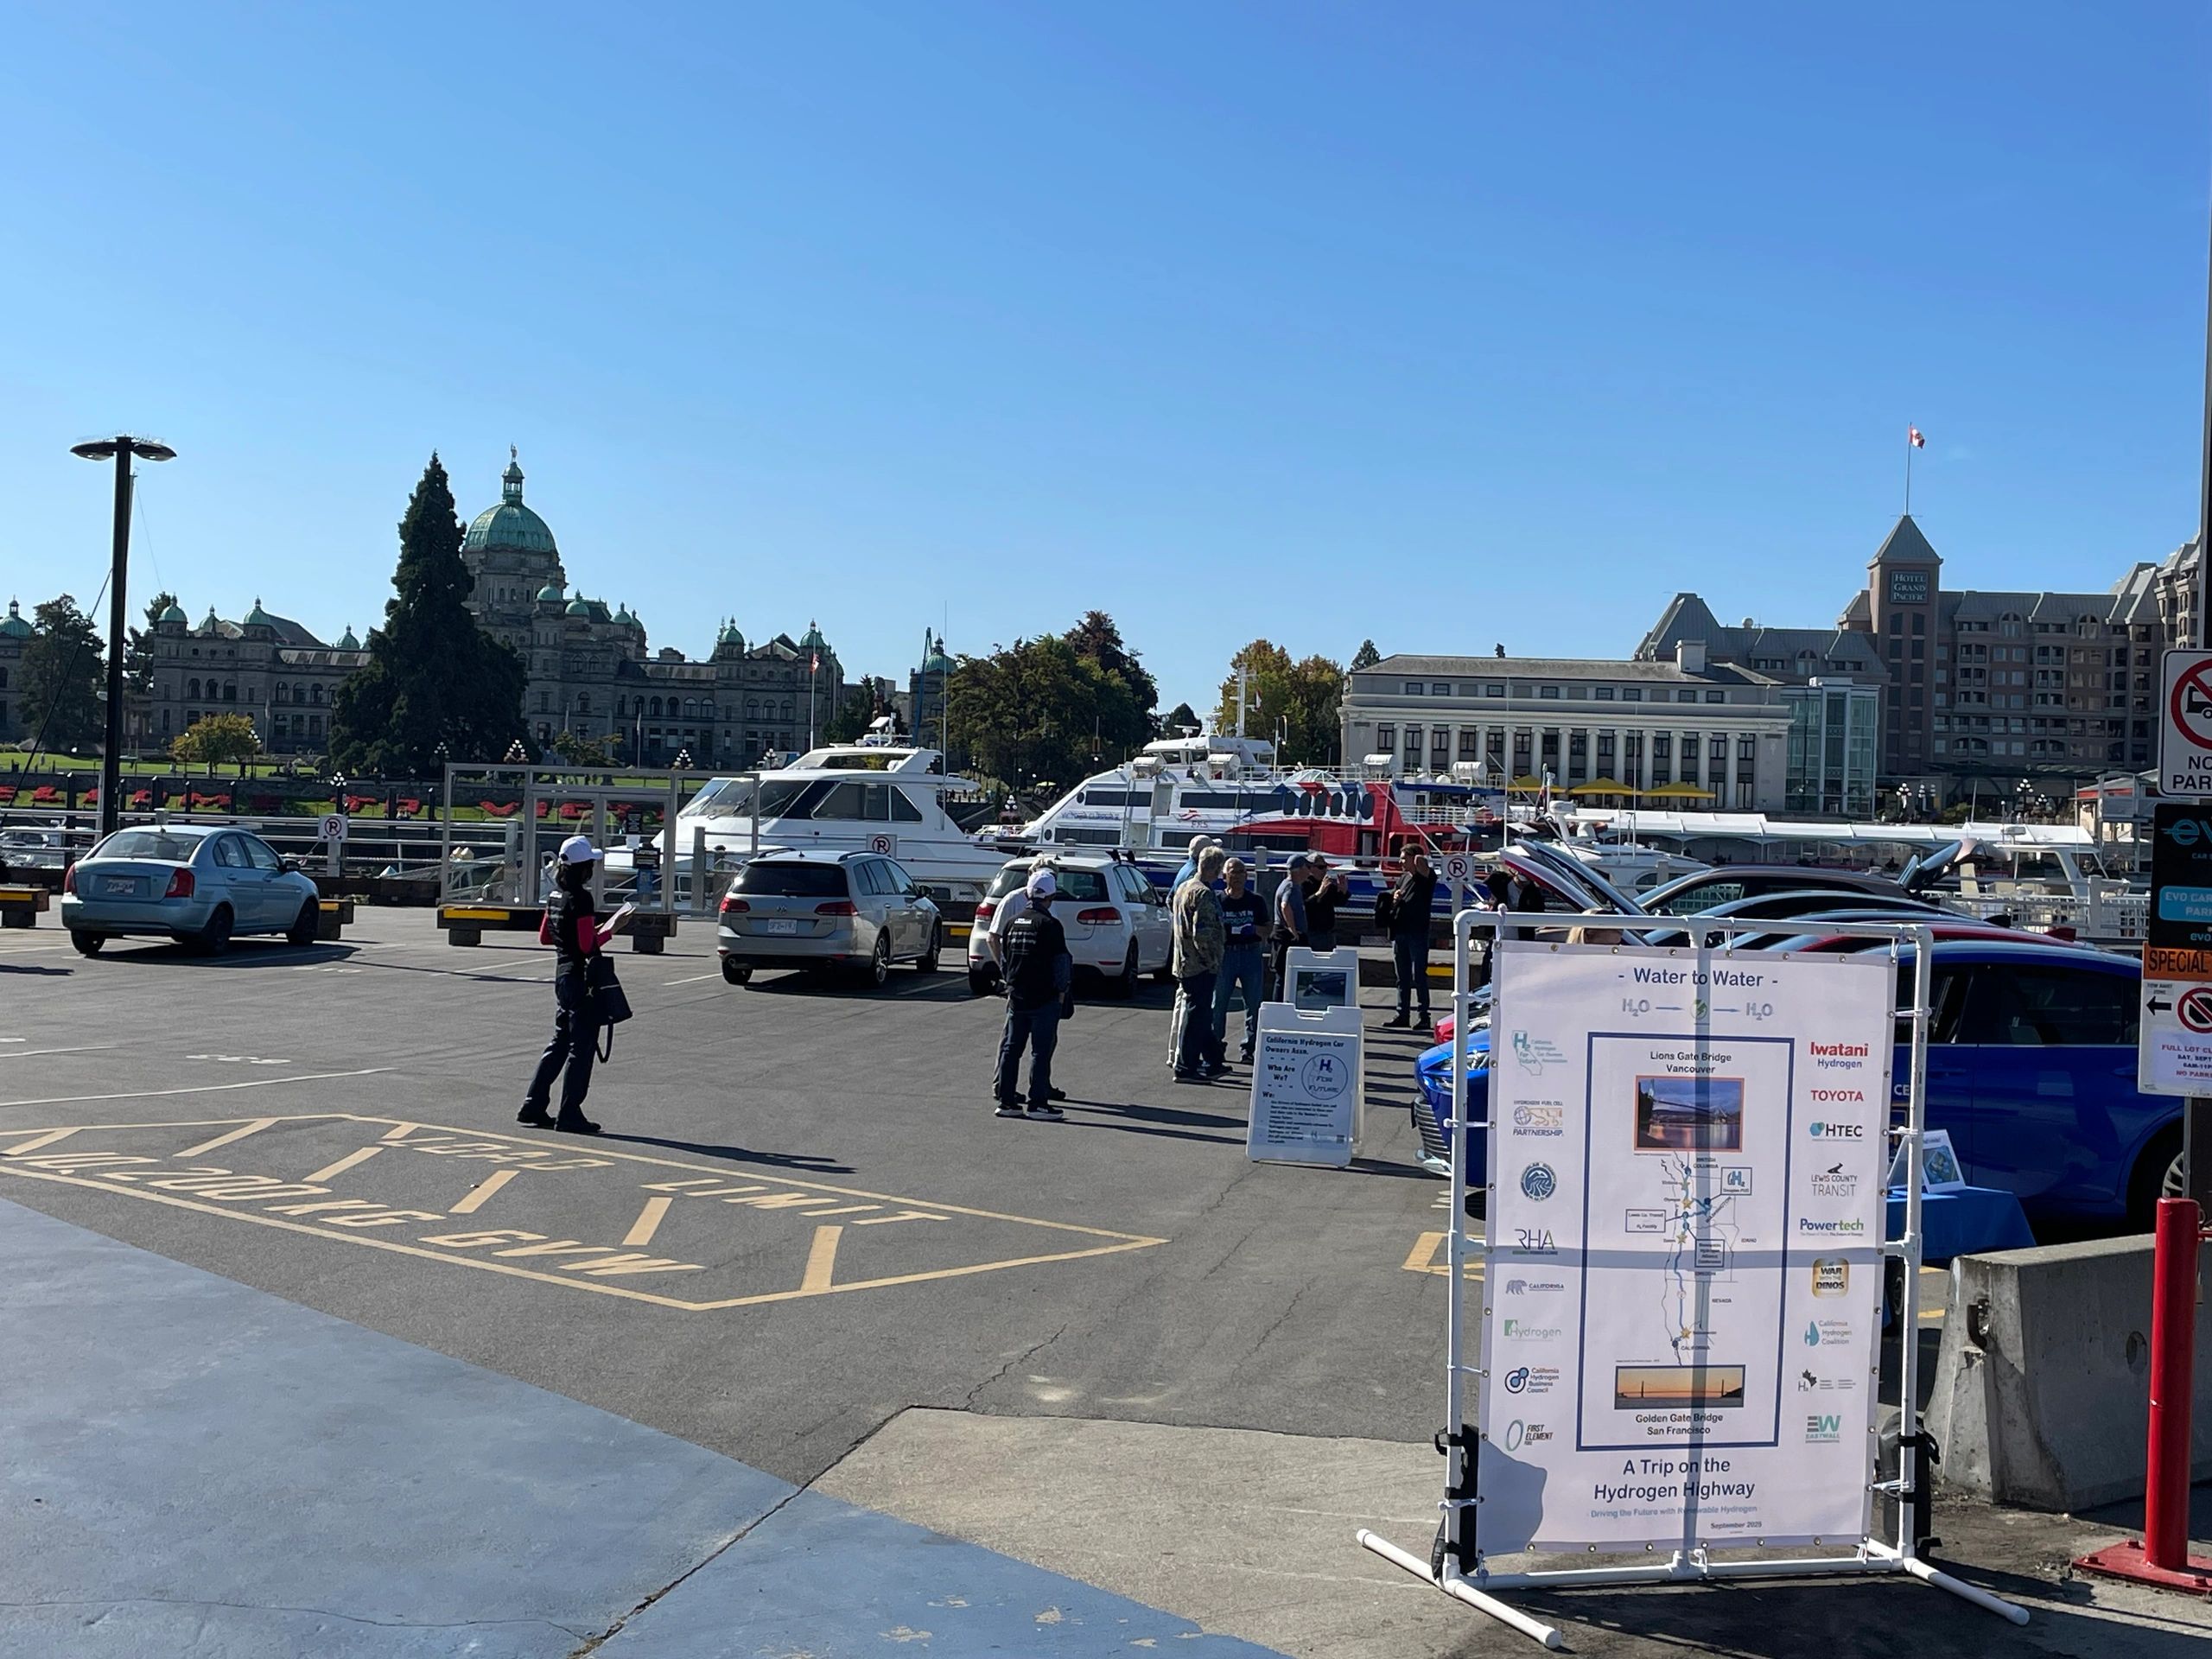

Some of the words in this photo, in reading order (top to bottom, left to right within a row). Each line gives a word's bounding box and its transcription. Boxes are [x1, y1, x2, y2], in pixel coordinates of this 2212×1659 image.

[1894, 582, 1925, 592] GRAND
[2185, 906, 2212, 917] PAR
[2148, 950, 2209, 974] SPECIAL
[1633, 967, 1688, 985] Water
[1692, 970, 1708, 986] to
[1713, 970, 1764, 988] Water
[1267, 1036, 1298, 1045] California
[1300, 1039, 1331, 1047] Hydrogen
[1810, 1041, 1868, 1057] Iwatani
[1650, 1051, 1675, 1061] Lions
[1677, 1052, 1699, 1061] Gate
[1700, 1052, 1732, 1063] Bridge
[1666, 1065, 1716, 1074] Vancouver
[1817, 1058, 1862, 1070] Hydrogen
[1811, 1090, 1864, 1102] TOYOTA
[1826, 1123, 1863, 1137] HTEC
[1811, 1184, 1856, 1197] TRANSIT
[640, 1178, 952, 1225] LIMIT
[3, 1152, 333, 1202] 10,200
[263, 1198, 447, 1228] KG
[418, 1229, 707, 1276] GVW
[1800, 1218, 1864, 1230] Powertech
[1515, 1229, 1555, 1250] RHA
[1635, 1414, 1668, 1423] Golden
[1669, 1414, 1692, 1422] Gate
[1693, 1414, 1724, 1424] Bridge
[1526, 1424, 1545, 1433] FIRST
[1647, 1427, 1664, 1436] San
[1666, 1426, 1711, 1435] Francisco
[1525, 1433, 1554, 1441] ELEMENT
[1623, 1459, 1635, 1476] A
[1640, 1459, 1674, 1478] Trip
[1679, 1461, 1699, 1474] on
[1704, 1457, 1731, 1472] the
[1594, 1484, 1678, 1503] Hydrogen
[1683, 1481, 1756, 1500] Highway
[1591, 1510, 1618, 1519] Driving
[1659, 1507, 1676, 1516] with
[1720, 1505, 1758, 1514] Hydrogen
